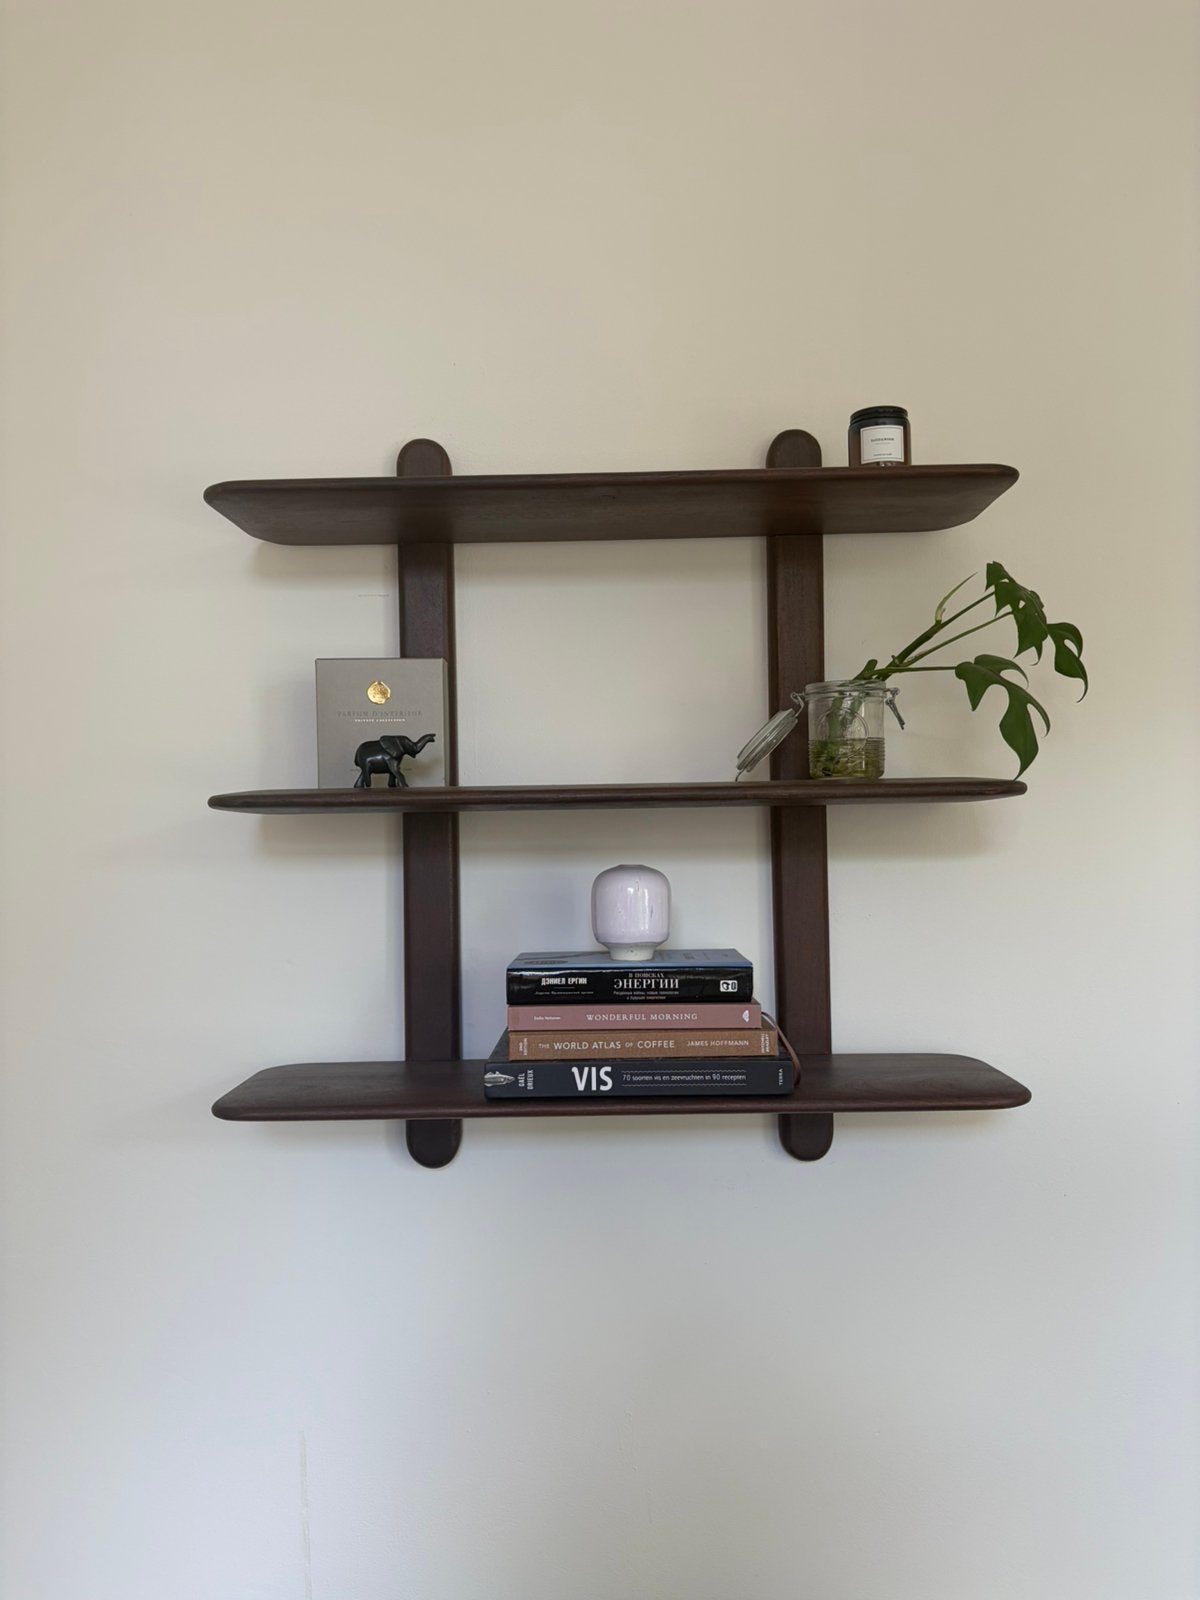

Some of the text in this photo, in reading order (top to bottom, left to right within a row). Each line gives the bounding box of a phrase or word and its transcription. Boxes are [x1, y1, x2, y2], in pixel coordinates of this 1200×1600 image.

[541, 977, 588, 986] ДЭНИЕЛ ЕРГИН
[613, 978, 679, 989] ЭНЕРГИИ
[650, 1013, 698, 1021] MORNING
[553, 1042, 589, 1050] WORLD
[592, 1041, 622, 1049] ATLAS
[637, 1040, 675, 1049] COFFEE
[571, 1066, 613, 1092] VIS
